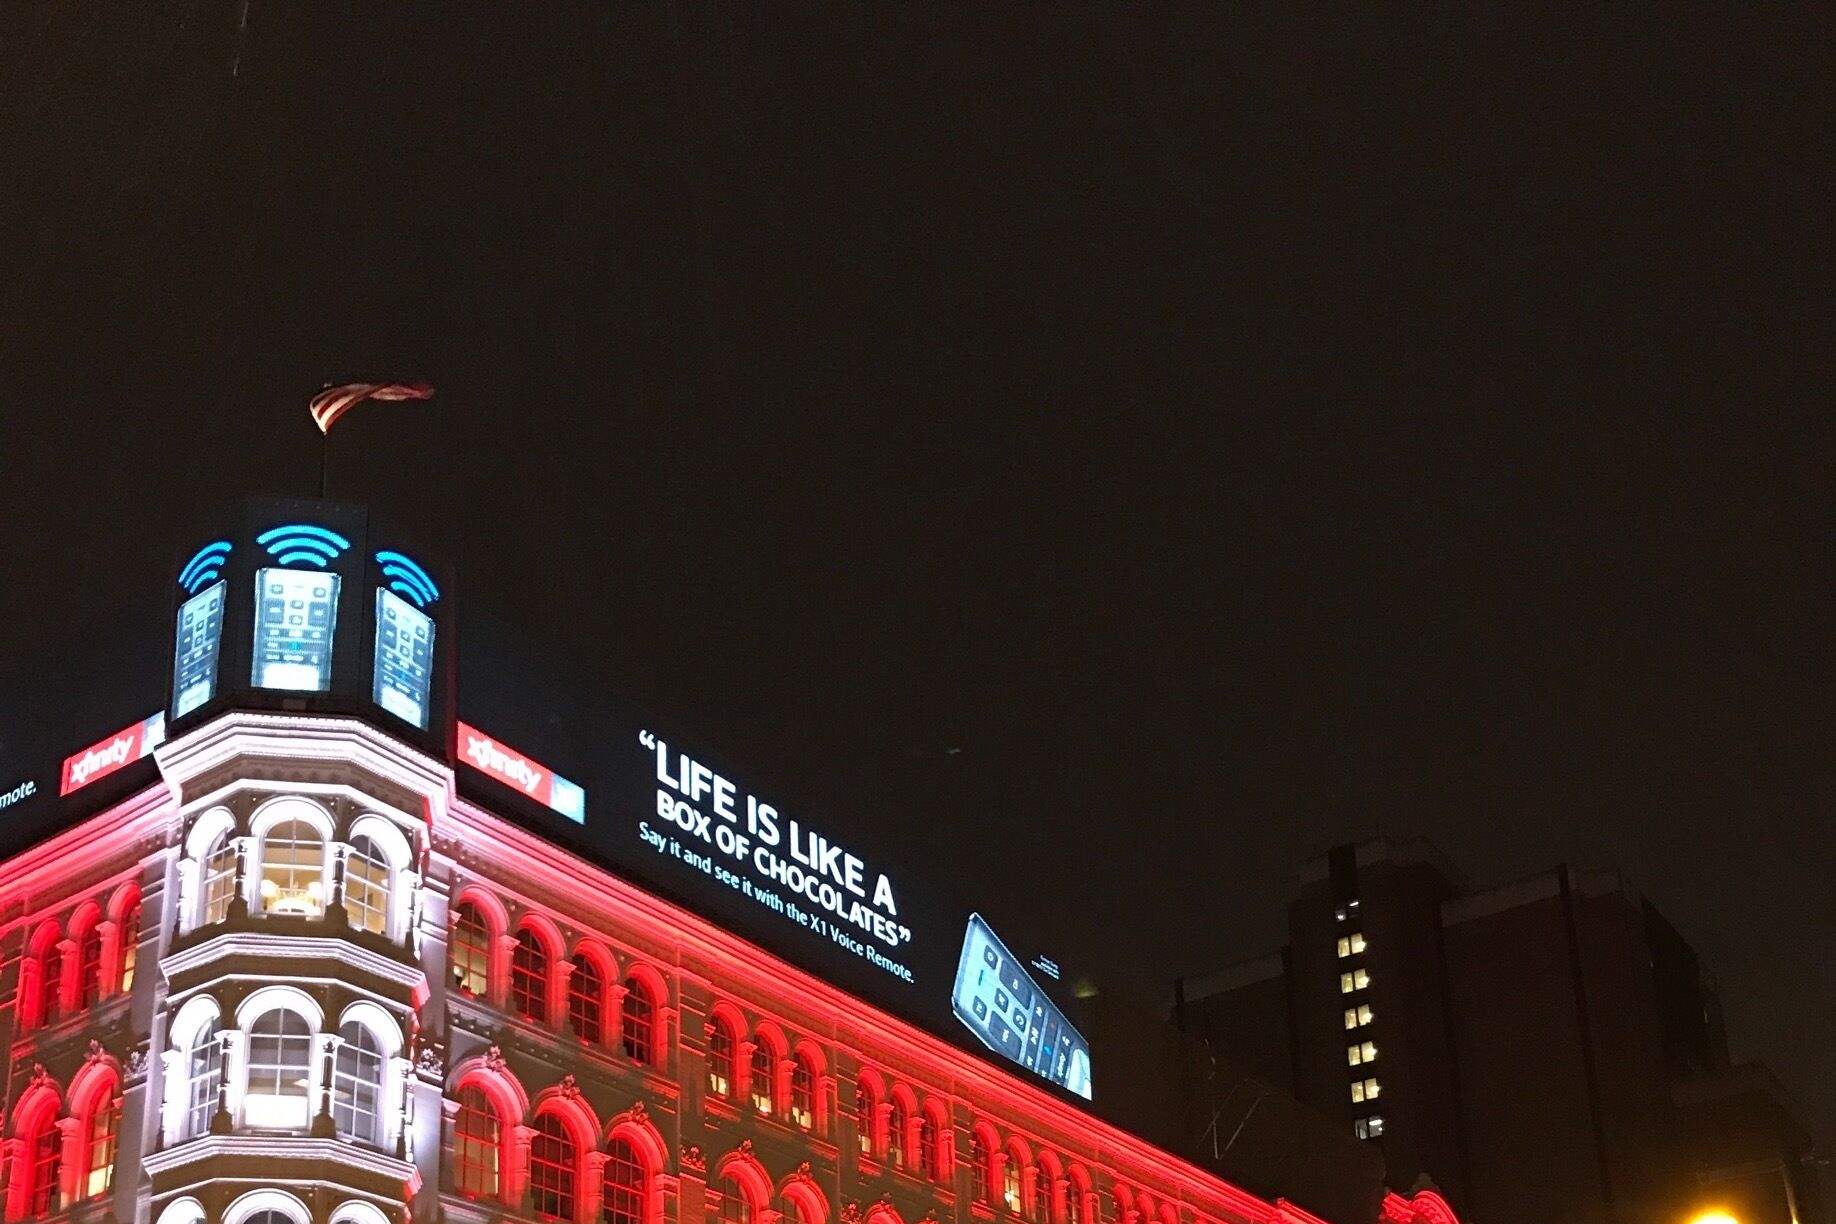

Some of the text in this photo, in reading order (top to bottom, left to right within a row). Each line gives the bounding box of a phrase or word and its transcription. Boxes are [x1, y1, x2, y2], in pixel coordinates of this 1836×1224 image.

[70, 735, 135, 784] xfinity
[467, 736, 541, 792] xfinity
[656, 789, 712, 843] BOX
[715, 824, 750, 861] OF
[747, 794, 780, 846] IS
[789, 819, 866, 897] LIKE
[873, 873, 897, 916] A
[639, 821, 915, 984] Say it and see it with the X1 Voice Remote.
